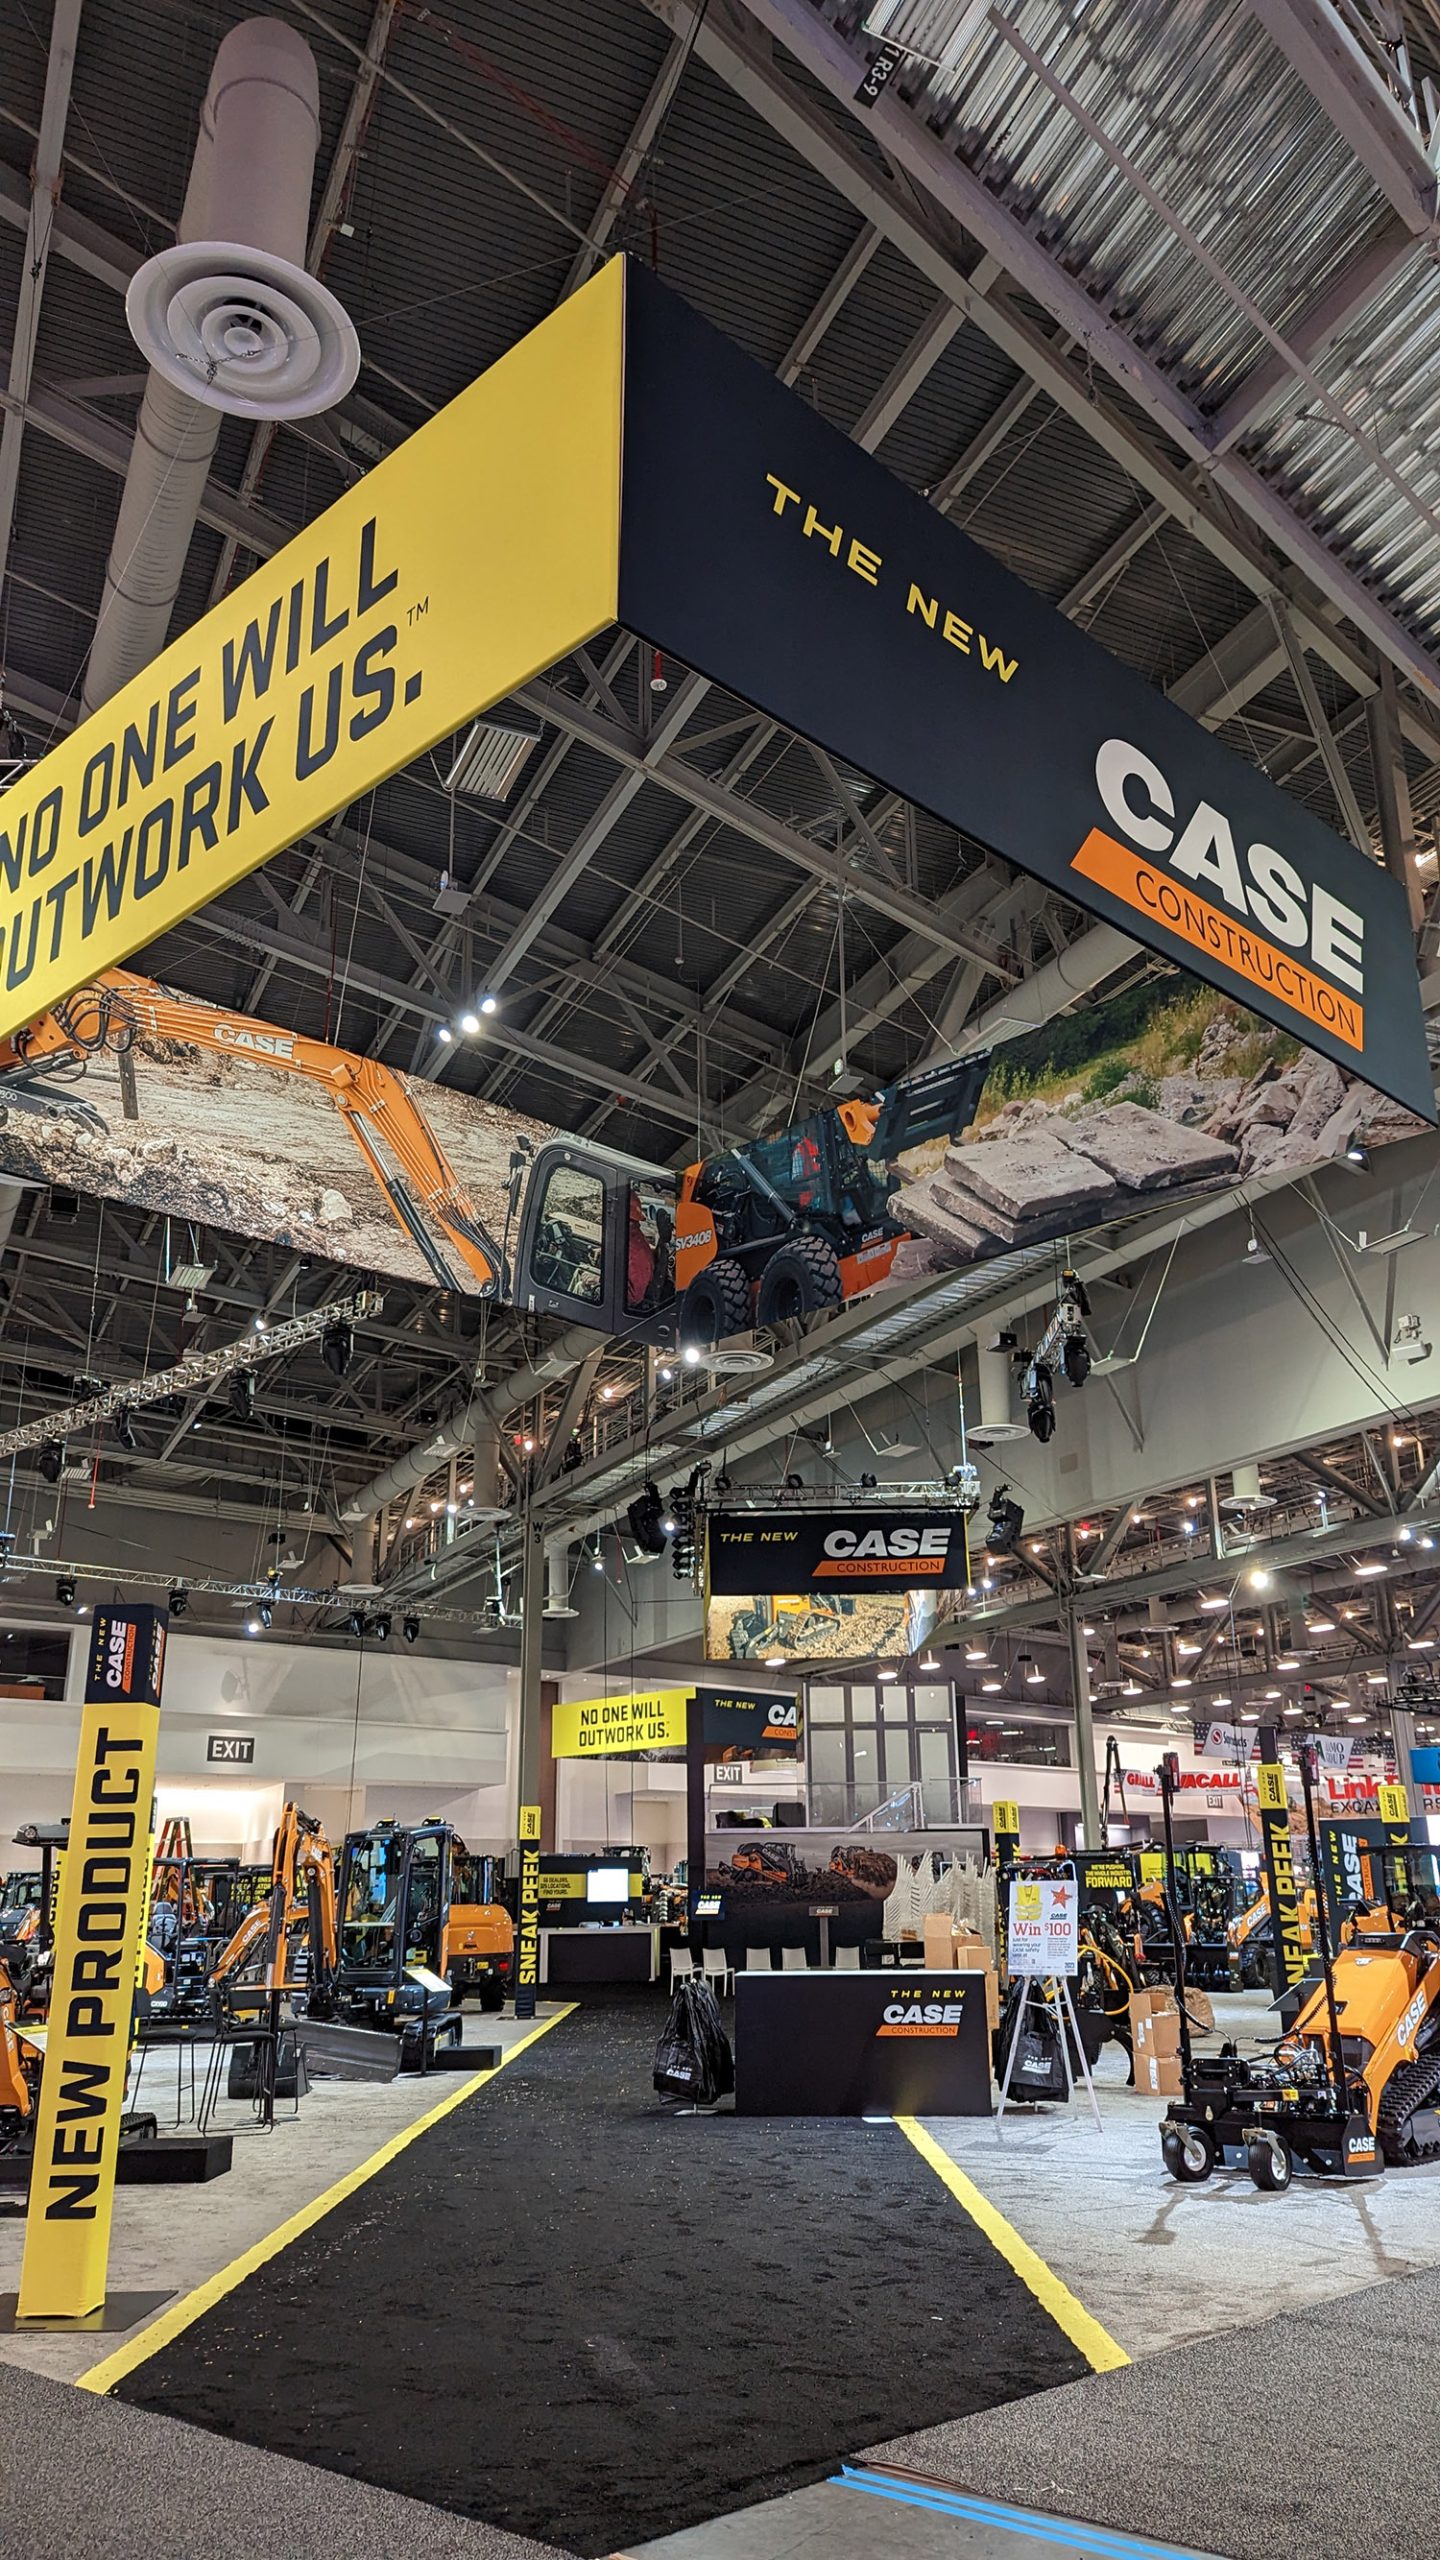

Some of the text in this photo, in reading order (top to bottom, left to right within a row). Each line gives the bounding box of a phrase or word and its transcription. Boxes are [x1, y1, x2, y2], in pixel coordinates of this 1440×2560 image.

[863, 56, 895, 96] R3-9
[765, 473, 1019, 683] THE NEW
[78, 666, 202, 838] ONE
[221, 516, 399, 725] WILL
[0, 716, 275, 990] UTWORK
[1095, 738, 1364, 995] CASE
[1135, 868, 1357, 1039] CONSTRUCTION
[213, 1023, 294, 1059] CASE
[675, 1230, 712, 1251] SV340B
[861, 1226, 884, 1243] CASE
[532, 1521, 544, 1532] W
[534, 1533, 541, 1544] 3
[720, 1531, 798, 1543] THE NEW
[823, 1527, 952, 1558] CASE
[836, 1560, 941, 1573] CONSTRUCTION
[94, 1617, 107, 1681] THE NEW
[106, 1620, 127, 1688] CASE
[124, 1626, 135, 1681] CONSTRUCTION
[580, 1700, 665, 1726] NO ONE WILL
[714, 1699, 756, 1711] THE NEW
[579, 1721, 670, 1747] OUTWORK US.
[211, 1738, 252, 1760] EXIT
[715, 1766, 741, 1781] EXIT
[1209, 1795, 1222, 1807] EXIT
[1387, 1793, 1396, 1817] CASE
[526, 1812, 534, 1835] CASE
[1329, 1831, 1338, 1864] NEW
[1086, 1876, 1132, 1888] FORWARD
[519, 1849, 540, 1984] SNEAK PEEK
[698, 1901, 721, 1909] CASE
[1246, 1903, 1267, 1927] CASE
[242, 1919, 262, 1943] CASE
[1013, 1922, 1072, 1936] Win $100
[45, 1727, 146, 2220] NEW PRODUCT
[891, 1990, 966, 1998] THE NEW
[883, 2004, 963, 2024] CASE
[1396, 1989, 1428, 2047] CASE
[666, 2068, 691, 2081] CASE
[1024, 2060, 1052, 2070] CASE
[1349, 2137, 1376, 2153] CASE
